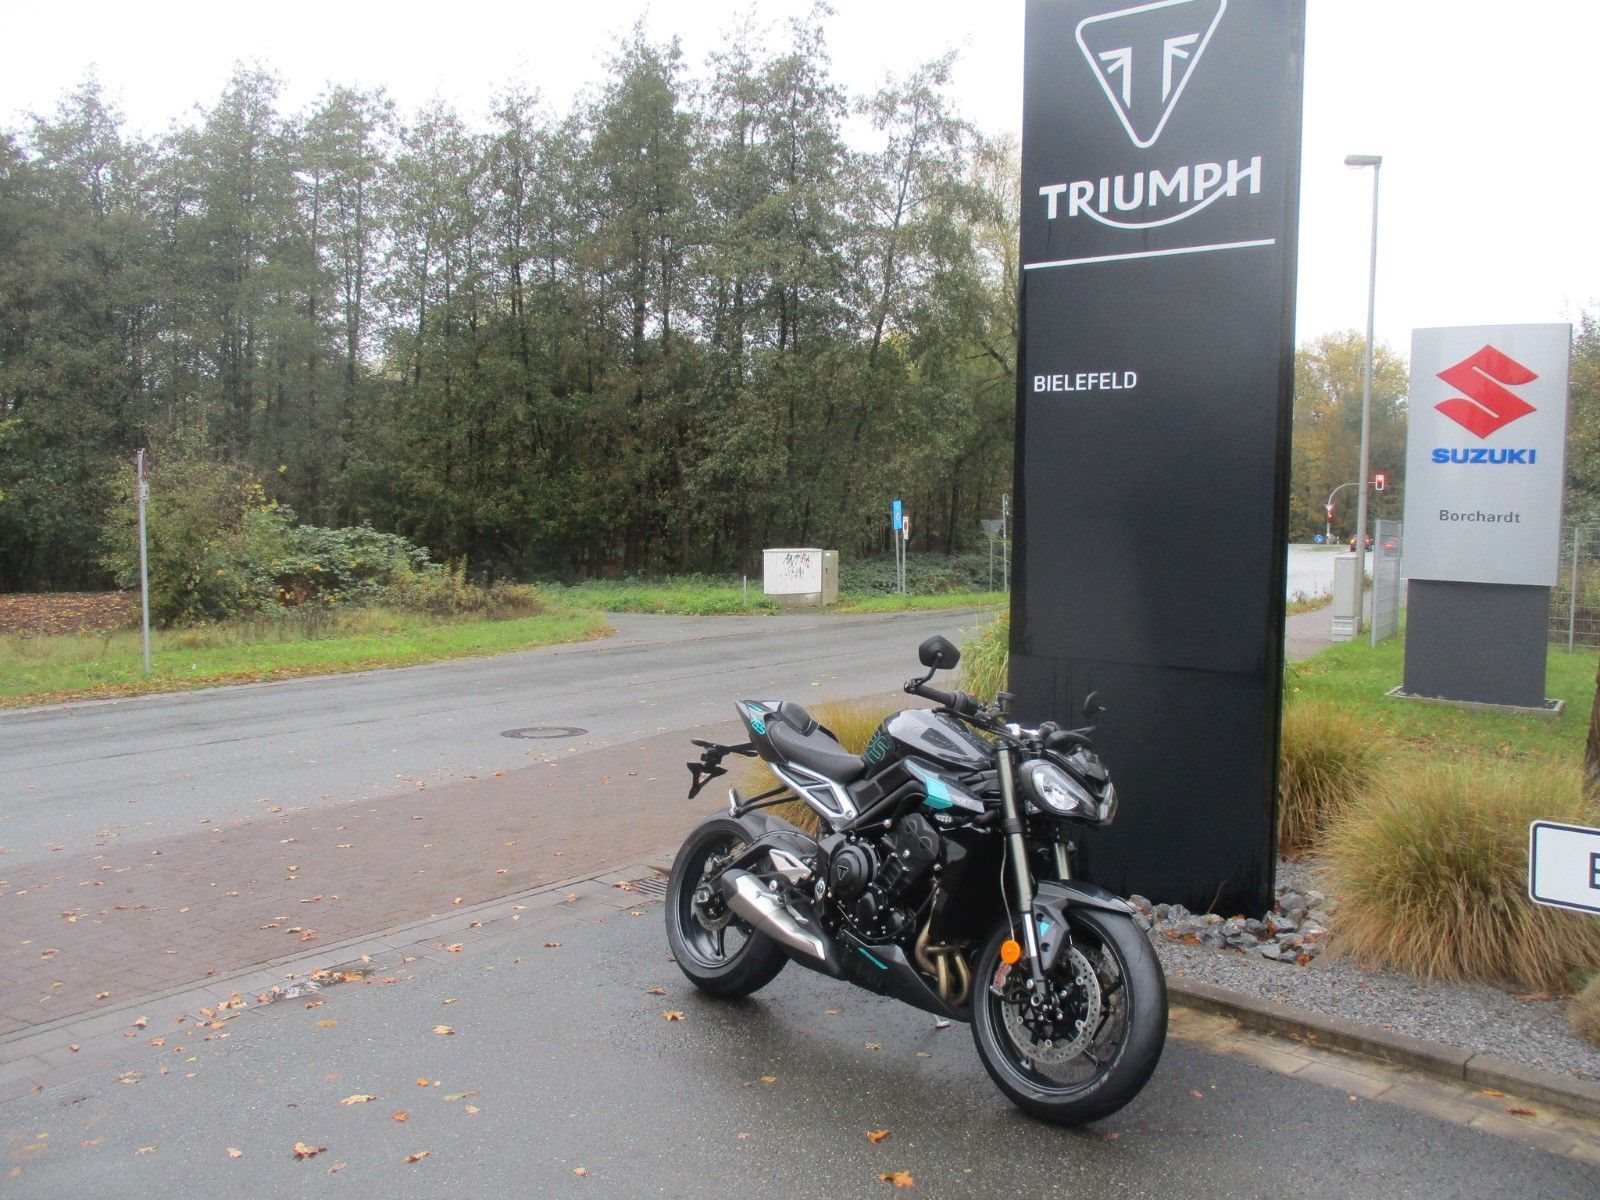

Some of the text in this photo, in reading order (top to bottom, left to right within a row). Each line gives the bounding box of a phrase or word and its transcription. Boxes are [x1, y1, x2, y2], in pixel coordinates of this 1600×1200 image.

[1038, 155, 1262, 229] TRIUMPH
[1033, 371, 1138, 393] BIELEFELD
[1431, 447, 1537, 465] SUZUKI
[1438, 509, 1521, 524] Borchardt
